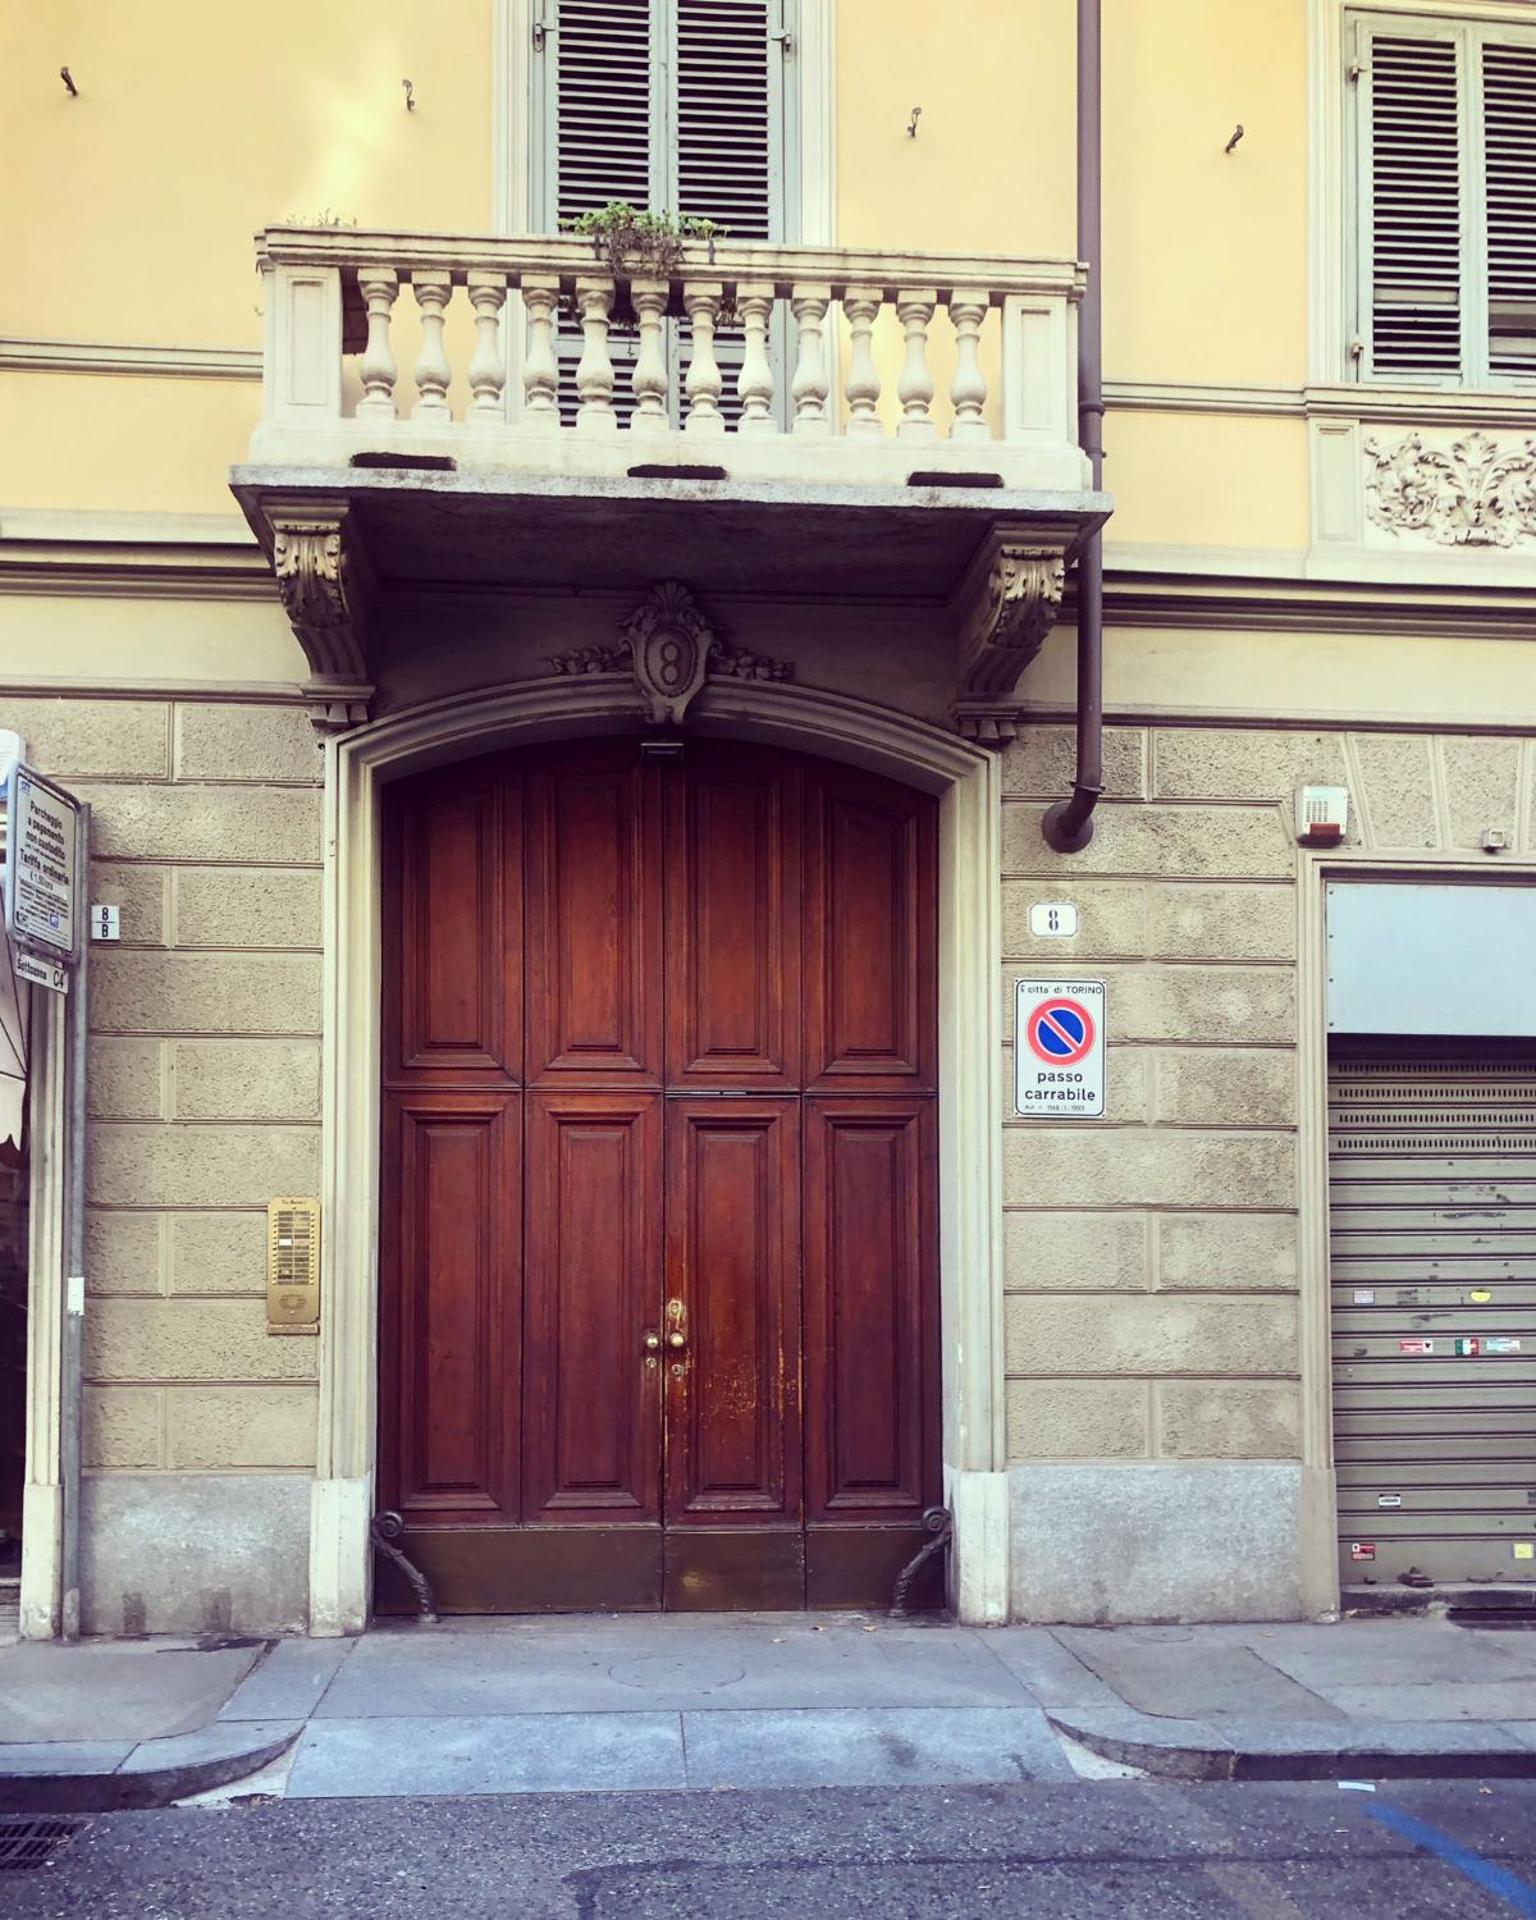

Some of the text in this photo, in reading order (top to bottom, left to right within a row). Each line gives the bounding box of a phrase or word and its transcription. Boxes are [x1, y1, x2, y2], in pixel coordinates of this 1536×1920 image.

[660, 641, 682, 686] 8
[30, 800, 62, 829] Parcheggio
[32, 819, 65, 846] pagamento
[20, 847, 41, 870] Tariffa
[101, 906, 109, 920] 8
[1048, 909, 1059, 931] 8
[53, 970, 64, 989] C4
[1053, 986, 1063, 994] di
[1066, 986, 1103, 995] TORINO
[1037, 1072, 1083, 1084] passo
[1024, 1087, 1096, 1101] carrabile
